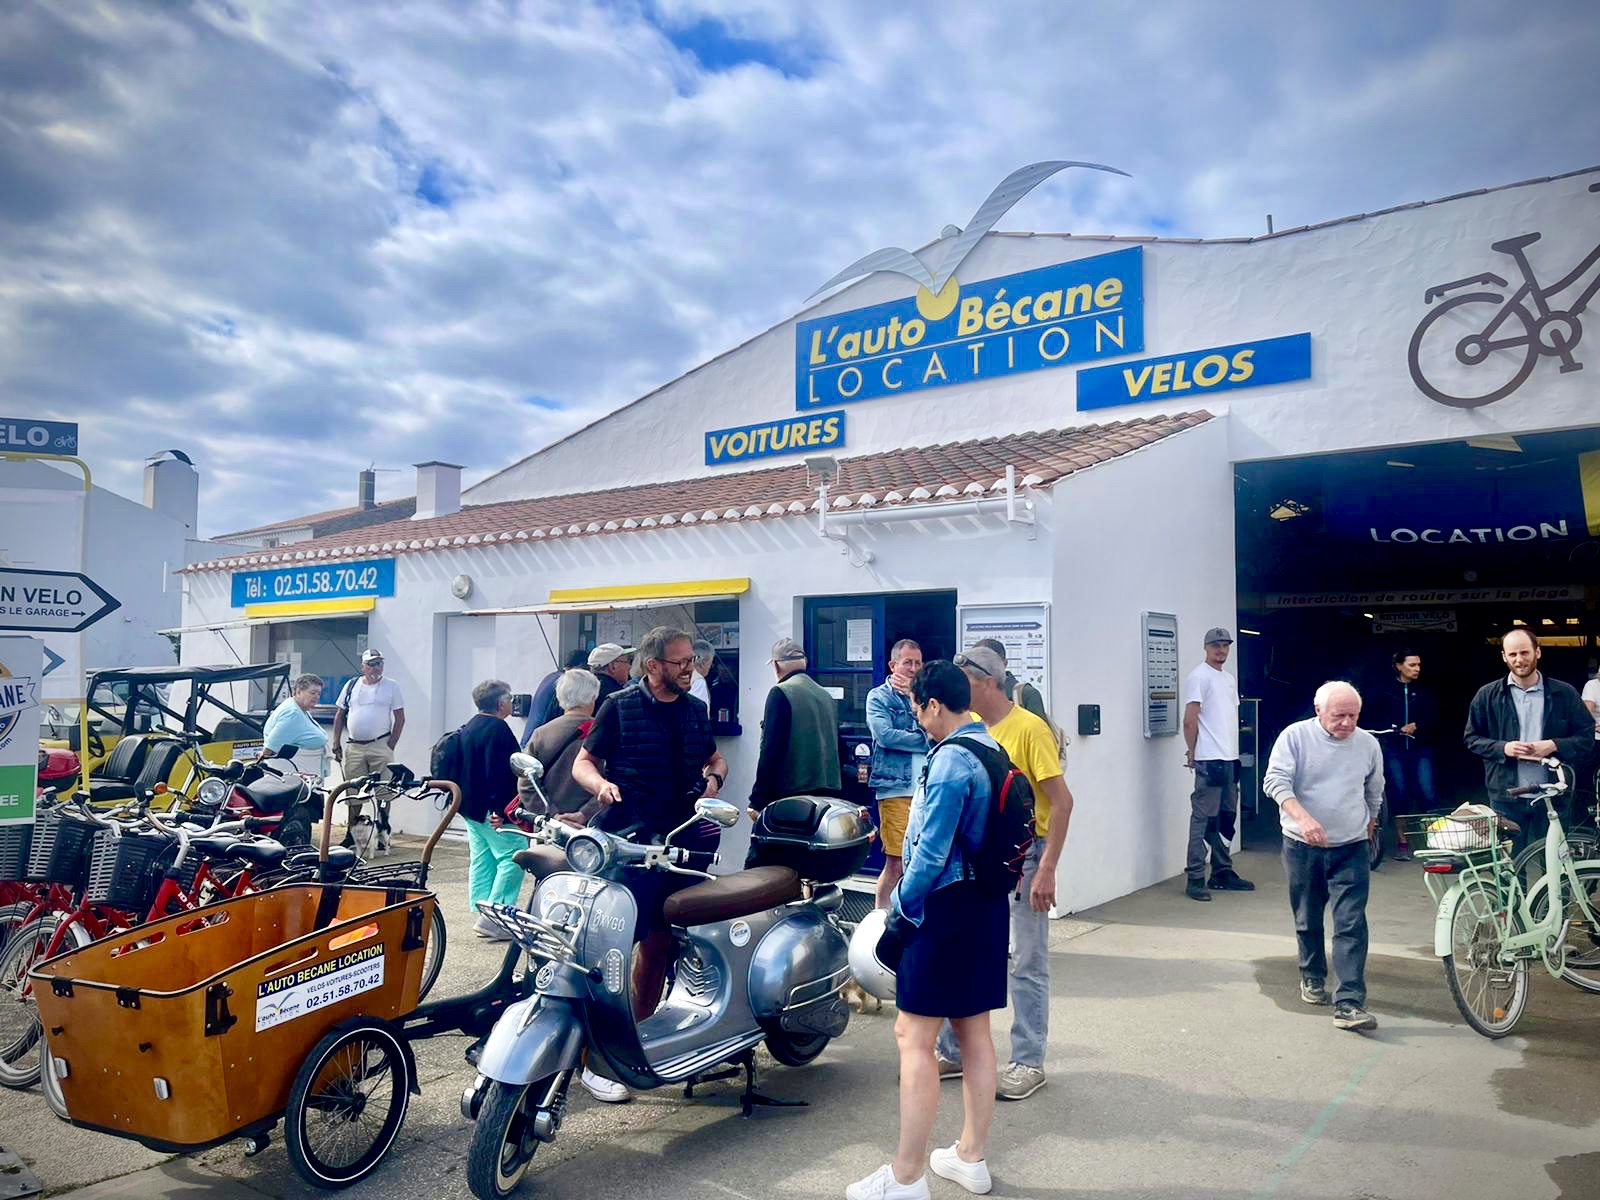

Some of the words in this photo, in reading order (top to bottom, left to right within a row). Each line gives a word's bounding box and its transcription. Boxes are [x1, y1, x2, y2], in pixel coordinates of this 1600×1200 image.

[809, 315, 927, 366] L'auto
[957, 277, 1124, 337] Bécane
[808, 315, 1126, 403] LOCATION
[1121, 348, 1256, 398] VELOS
[708, 416, 840, 460] VOITURES
[1370, 519, 1569, 544] LOCATION
[23, 587, 82, 605] VELO
[274, 566, 378, 597] 02.51.58.70.42
[1277, 594, 1369, 606] Interdiction
[1376, 593, 1394, 602] de
[1401, 591, 1456, 602] rouler
[1459, 591, 1490, 600] sur
[1495, 589, 1512, 599] la
[1517, 588, 1569, 601] plage
[9, 606, 22, 615] LE
[25, 607, 70, 617] GARAGE
[258, 976, 295, 997] L'AUTO
[297, 960, 337, 983] BECANE
[338, 943, 383, 969] LOCATION
[306, 973, 380, 1008] 02.51.58.70.42
